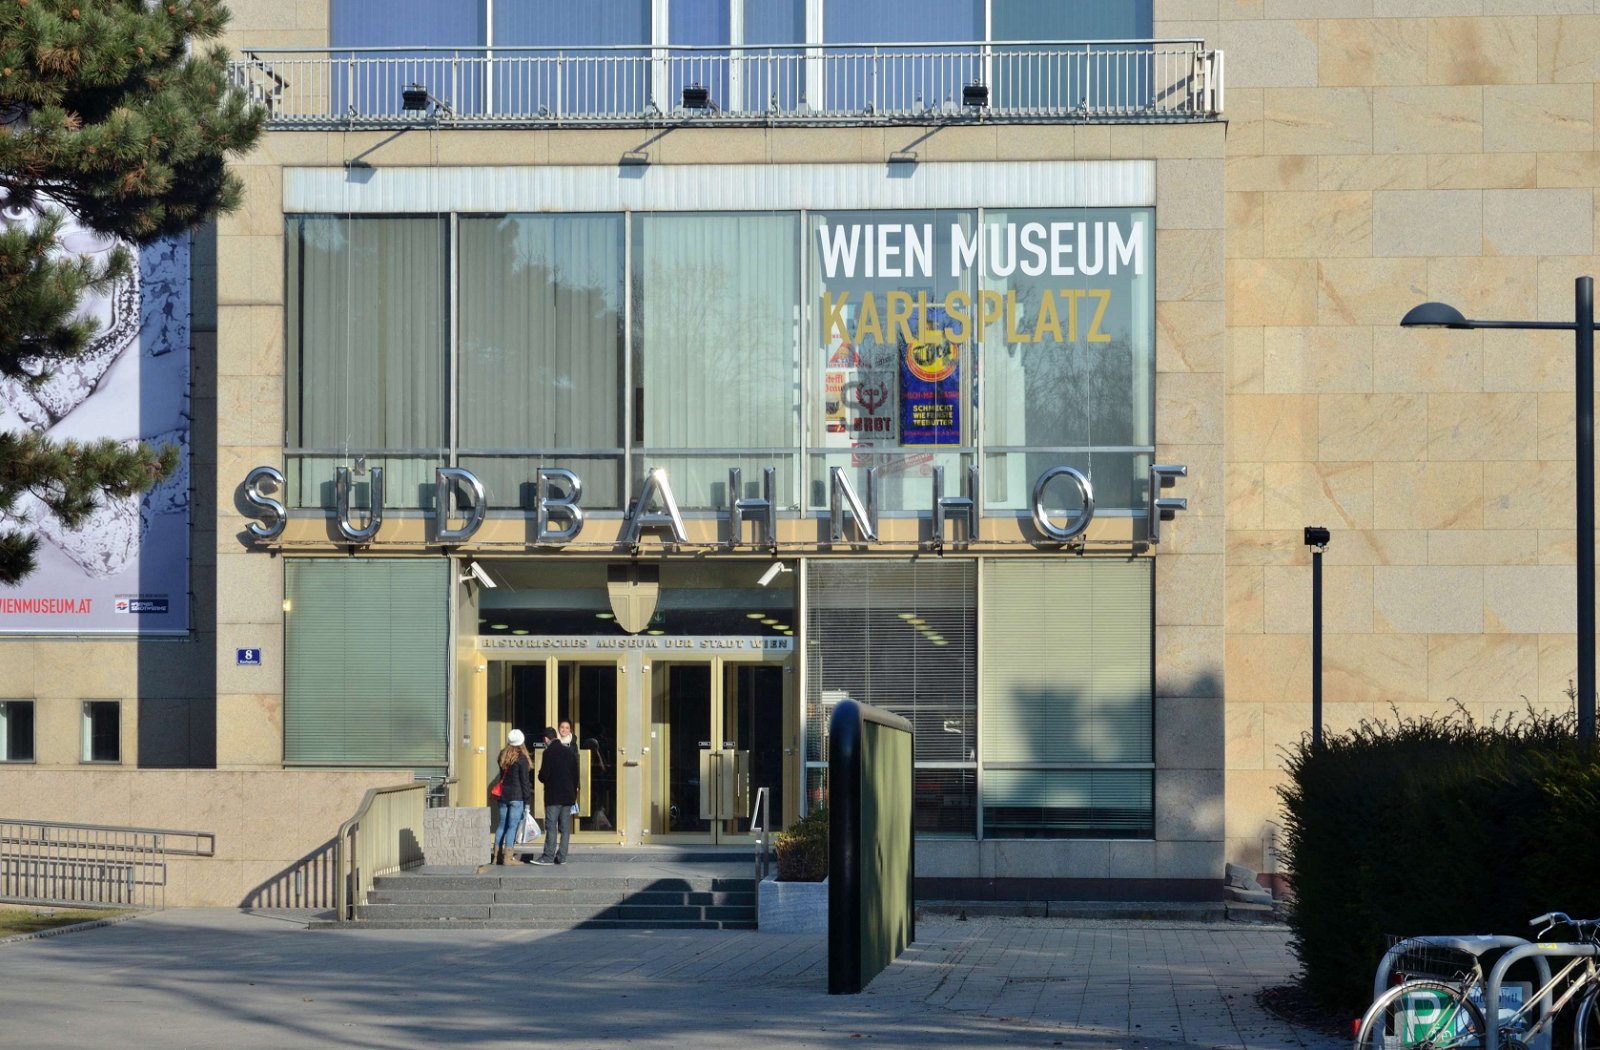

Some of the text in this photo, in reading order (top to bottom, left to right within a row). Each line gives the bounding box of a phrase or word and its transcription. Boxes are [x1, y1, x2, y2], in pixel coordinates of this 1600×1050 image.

[820, 222, 1144, 278] WIEN MUSEUM
[823, 288, 1112, 345] KARLSPLATZ
[245, 650, 253, 660] 8
[482, 639, 788, 648] HISTORISCHES MUSEUM DER STADT WIEN
[1406, 991, 1441, 1043] P
